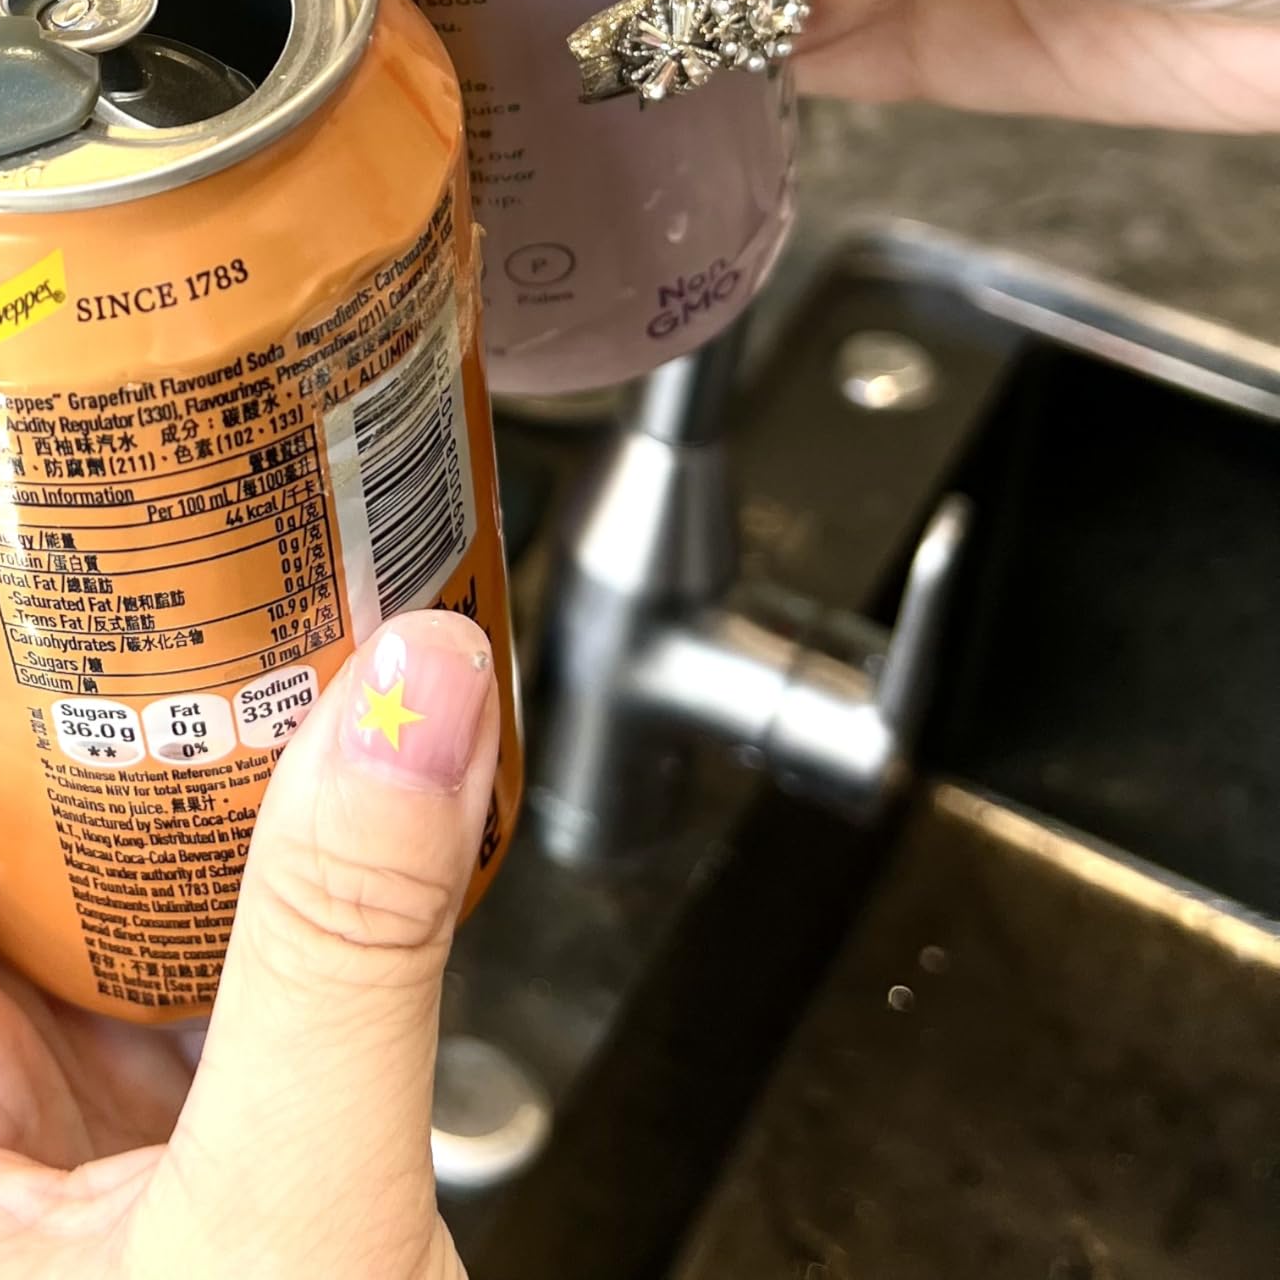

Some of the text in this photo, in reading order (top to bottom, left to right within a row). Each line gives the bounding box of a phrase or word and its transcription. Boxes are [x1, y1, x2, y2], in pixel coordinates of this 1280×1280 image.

[76, 281, 178, 322] SINCE
[185, 258, 249, 302] 1783
[658, 258, 726, 308] Non
[646, 269, 740, 338] GMO
[68, 382, 156, 412] Grapefruit
[161, 358, 243, 397] Flavoured
[247, 344, 285, 372] Soda
[296, 287, 374, 348] Ingredients:
[6, 415, 55, 437] Acidity
[60, 410, 135, 436] Regulator
[138, 400, 182, 427] (330),
[185, 377, 276, 415] Flavourings,
[276, 329, 356, 384] Preservative
[42, 486, 134, 505] Information
[147, 488, 234, 523] Per 100 mL
[226, 509, 244, 527] 44
[246, 494, 278, 520] kcal
[275, 517, 284, 533] 0
[287, 513, 296, 529] g
[33, 576, 57, 592] Fat
[278, 539, 287, 555] 0
[290, 537, 299, 551] g
[8, 591, 84, 612] -Saturated
[89, 596, 113, 613] Fat
[282, 558, 291, 574] 0
[293, 556, 302, 571] g
[12, 609, 57, 627] -Trans
[61, 614, 84, 631] Fat
[284, 578, 293, 593] 0
[296, 575, 305, 591] g
[10, 627, 116, 653] Carbohydrates
[268, 599, 297, 622] 10.9
[299, 596, 308, 613] g
[23, 651, 79, 672] -Sugars
[271, 620, 301, 643] 10.9
[303, 617, 311, 634] g
[20, 669, 74, 690] Sodium
[259, 652, 275, 669] 10
[279, 644, 301, 660] mg
[241, 670, 309, 704] Sodium
[60, 703, 200, 721] Sugars Fat
[242, 686, 313, 723] 33 mg
[62, 720, 136, 742] 36.0 g
[171, 720, 208, 737] 0 g
[272, 718, 298, 738] 2%
[182, 742, 208, 758] 0%
[56, 764, 67, 774] of
[69, 766, 116, 782] Chinese
[118, 770, 169, 783] Nutrient
[172, 765, 233, 781] Reference
[235, 755, 268, 771] Value
[105, 786, 130, 796] NRV
[133, 784, 151, 797] for
[153, 783, 182, 796] total
[185, 778, 225, 794] sugars
[228, 772, 250, 788] has
[47, 788, 169, 817] Contains no juice.
[51, 804, 256, 833] Manufactured by Swire Coca-Cola
[59, 838, 73, 853] by
[75, 846, 113, 862] Macau
[115, 849, 176, 865] Coca-Cola
[179, 846, 236, 863] Beverage
[82, 829, 112, 848] Hong
[114, 835, 148, 848] Kong.
[149, 831, 216, 846] Distributed
[218, 829, 229, 842] in
[93, 878, 148, 897] Fountain
[151, 885, 174, 897] and
[179, 882, 208, 896] 1783
[140, 866, 193, 883] authority
[195, 864, 207, 878] of
